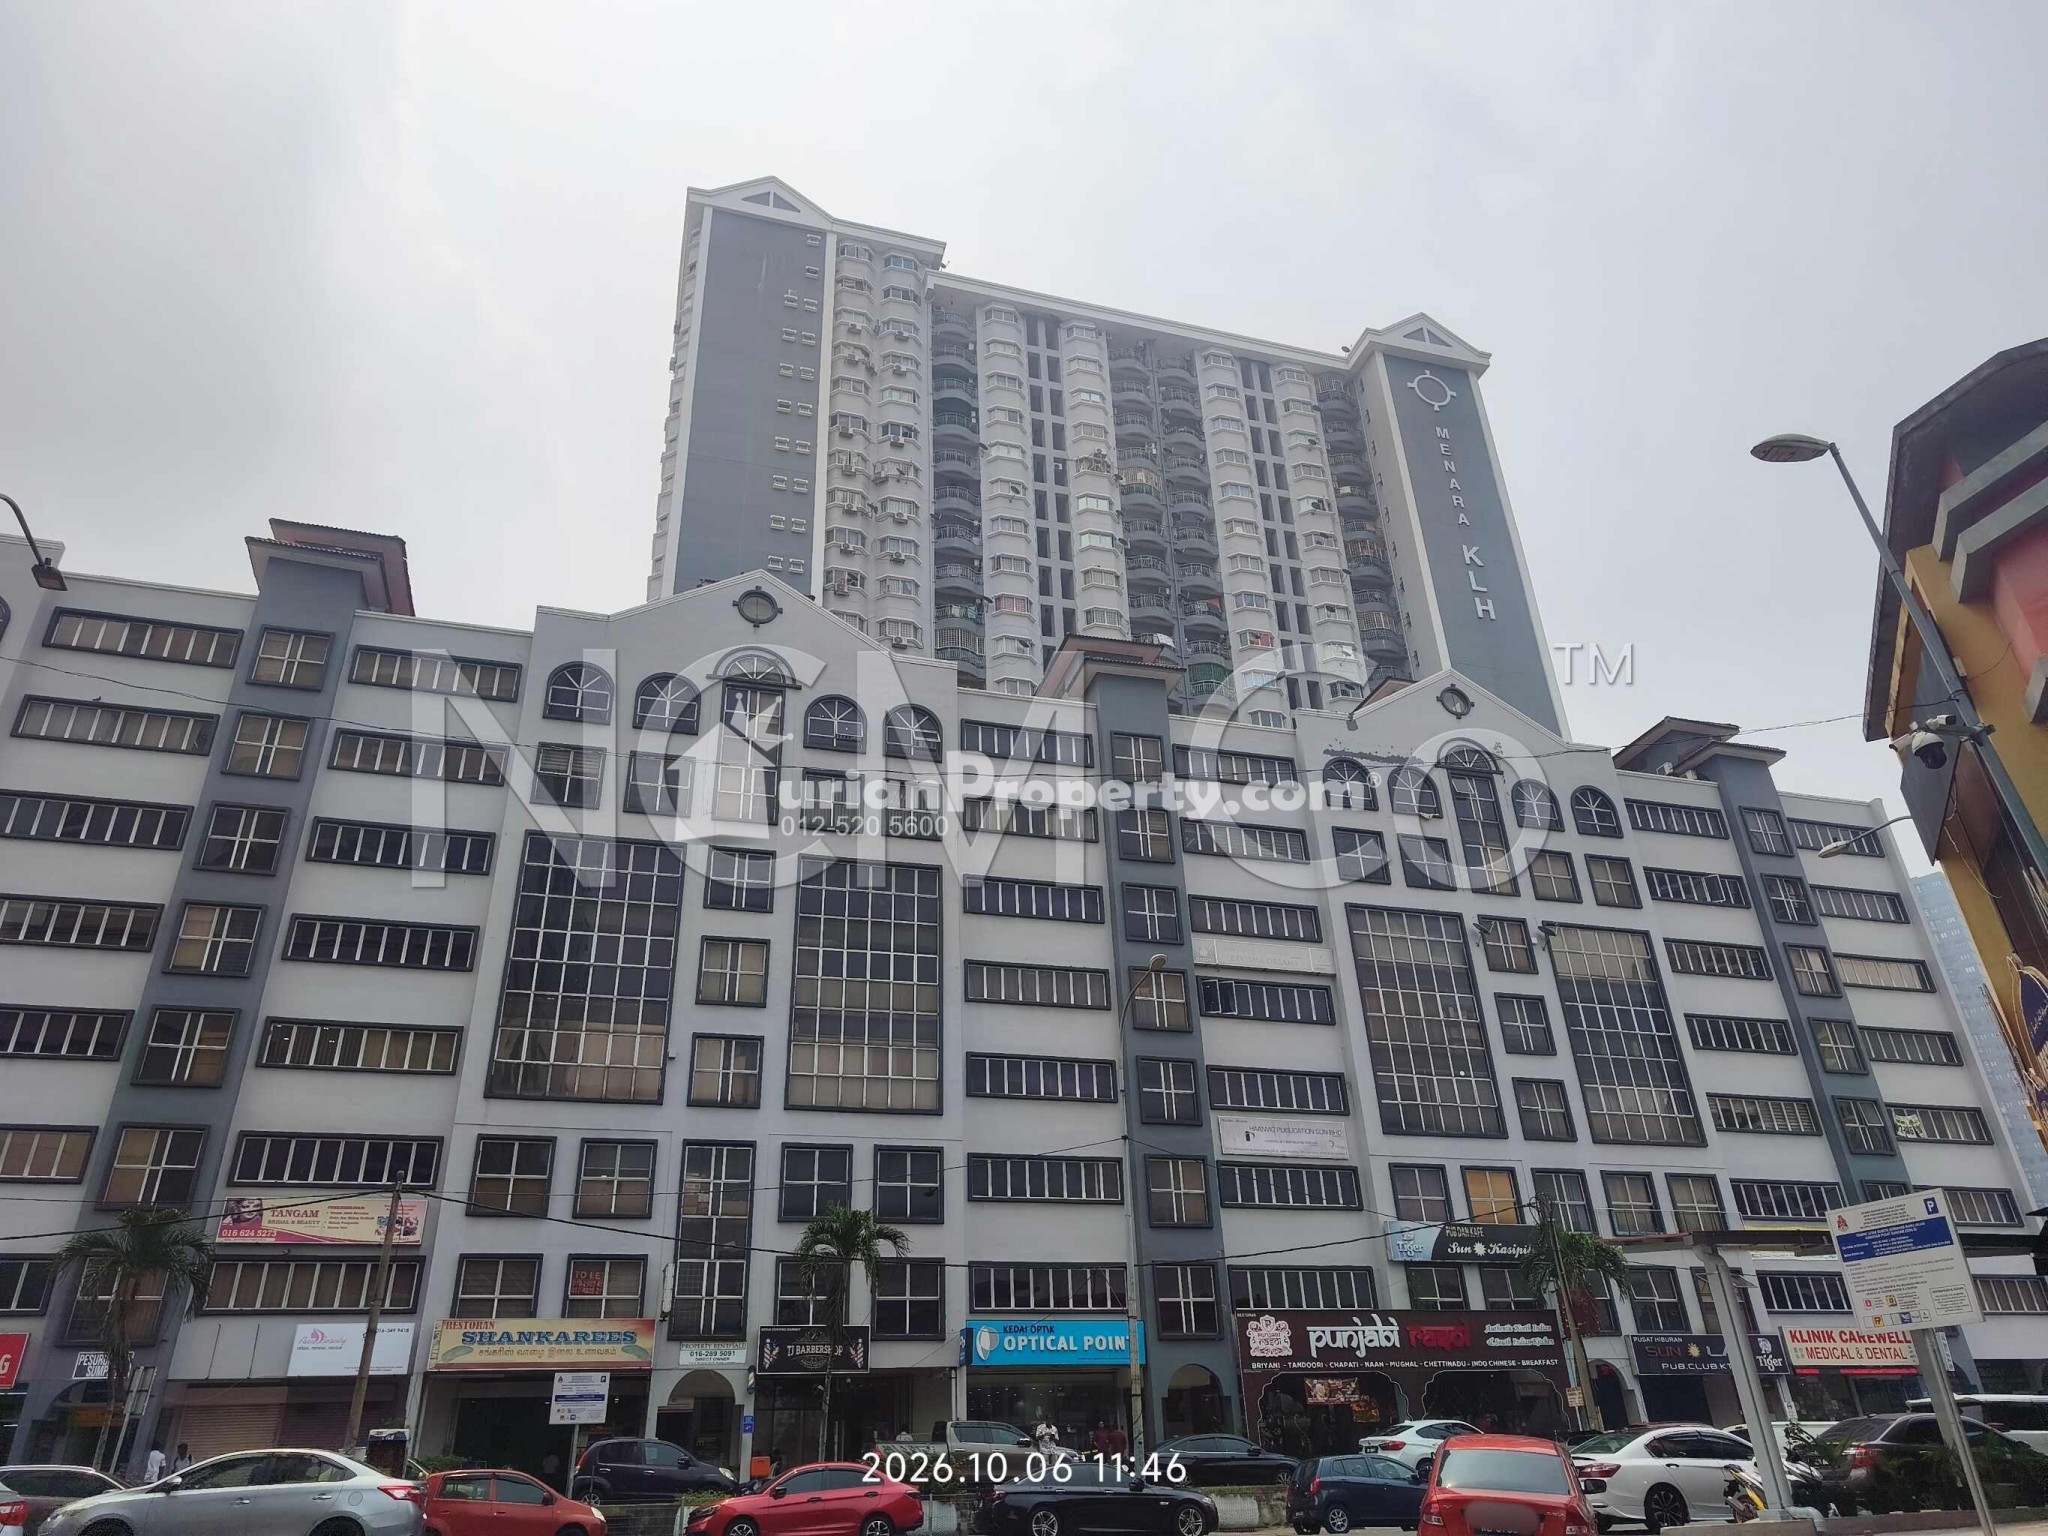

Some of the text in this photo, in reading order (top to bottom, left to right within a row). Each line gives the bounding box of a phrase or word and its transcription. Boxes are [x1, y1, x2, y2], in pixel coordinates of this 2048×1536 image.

[1436, 426, 1496, 620] MENARA KLH
[270, 1209, 319, 1218] TANGAM
[221, 1229, 277, 1237] 016 624 5273
[1445, 1225, 1484, 1237] PUB DAN KAFE
[1397, 1239, 1424, 1257] Tiger
[1447, 1241, 1473, 1254] Sun
[444, 1320, 495, 1330] RESTORAN
[1003, 1324, 1055, 1334] KEDAI OPTIK
[461, 1330, 638, 1346] SHANKAREES
[1003, 1335, 1130, 1351] OPTICAL POIN
[1306, 1313, 1401, 1359] punjabi
[1789, 1329, 1837, 1344] KLINIK
[1805, 1346, 1855, 1360] MEDICAL
[1855, 1346, 1863, 1359] &
[1865, 1346, 1908, 1360] DENTAL
[1288, 1361, 1324, 1369] TANDOORI
[1471, 1359, 1488, 1367] INDO
[1488, 1359, 1516, 1367] CHINESE
[1756, 1355, 1783, 1371] Tiger
